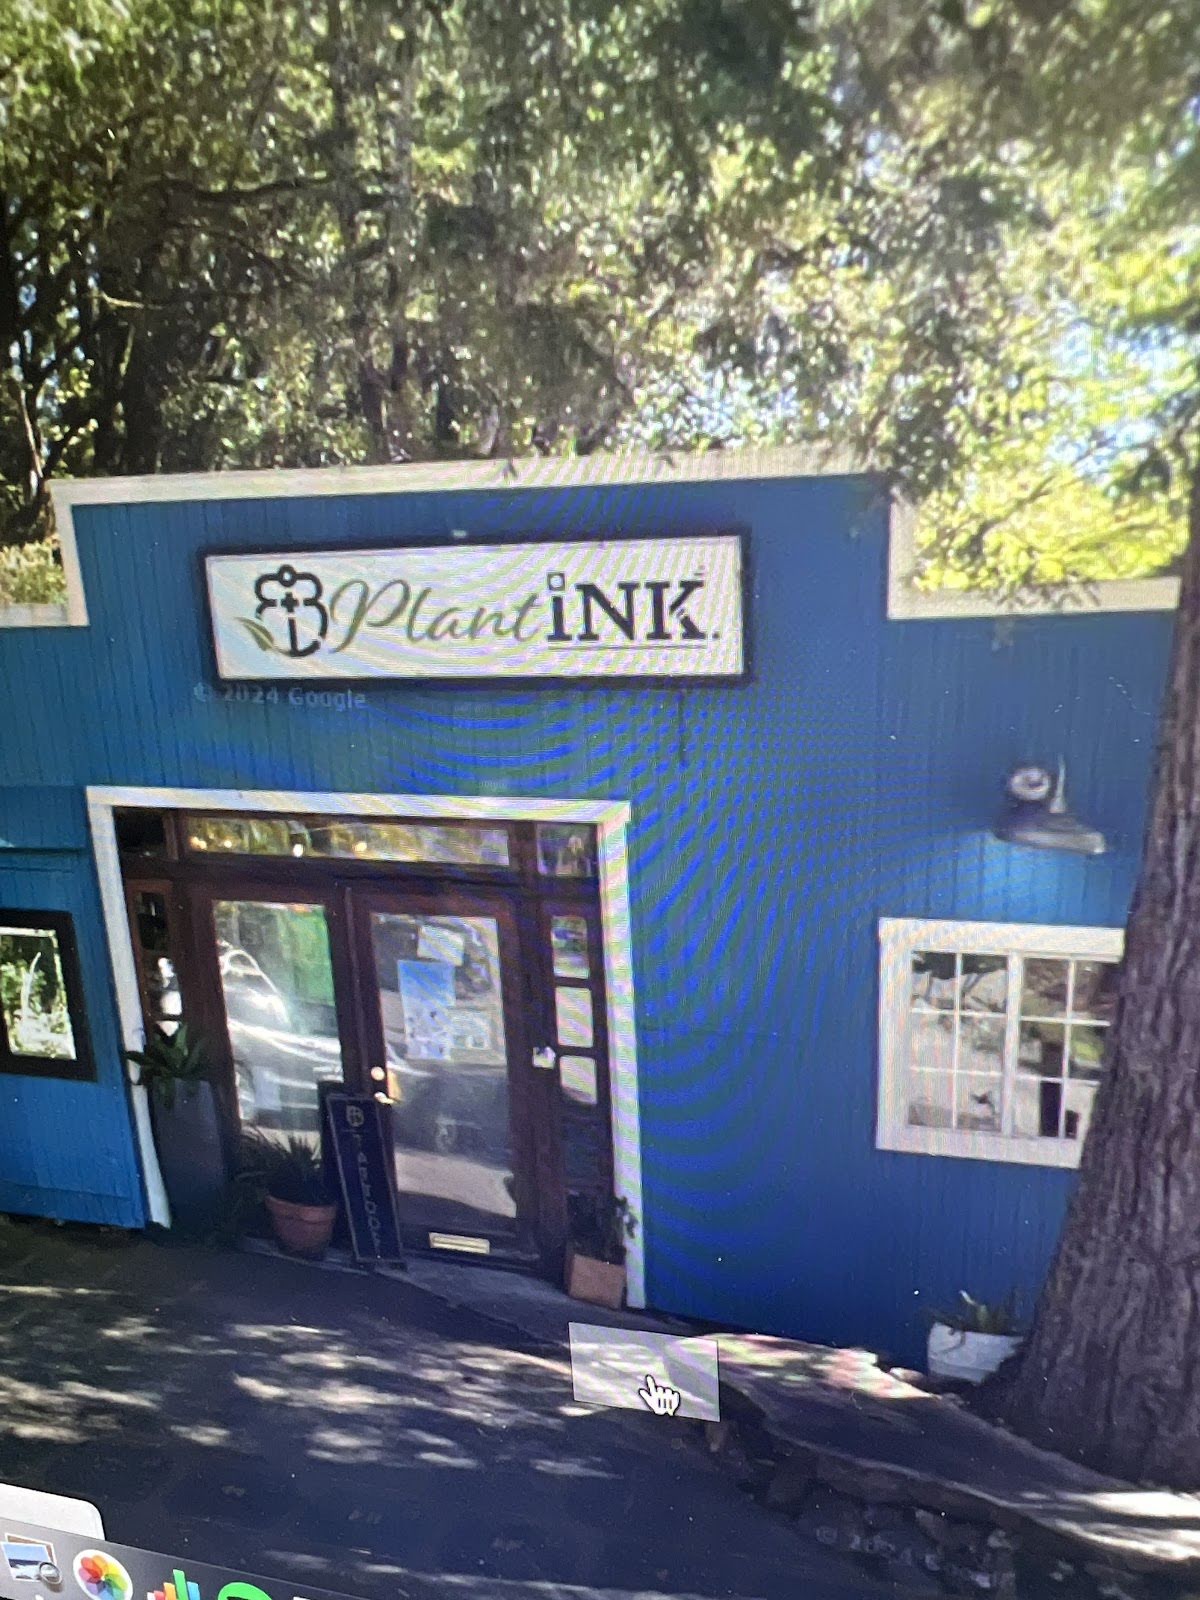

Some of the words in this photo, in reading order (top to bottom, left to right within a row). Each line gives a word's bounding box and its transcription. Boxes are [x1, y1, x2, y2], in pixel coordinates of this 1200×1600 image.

[329, 579, 545, 653] Plant
[223, 683, 279, 705] 2024
[288, 686, 367, 712] Google
